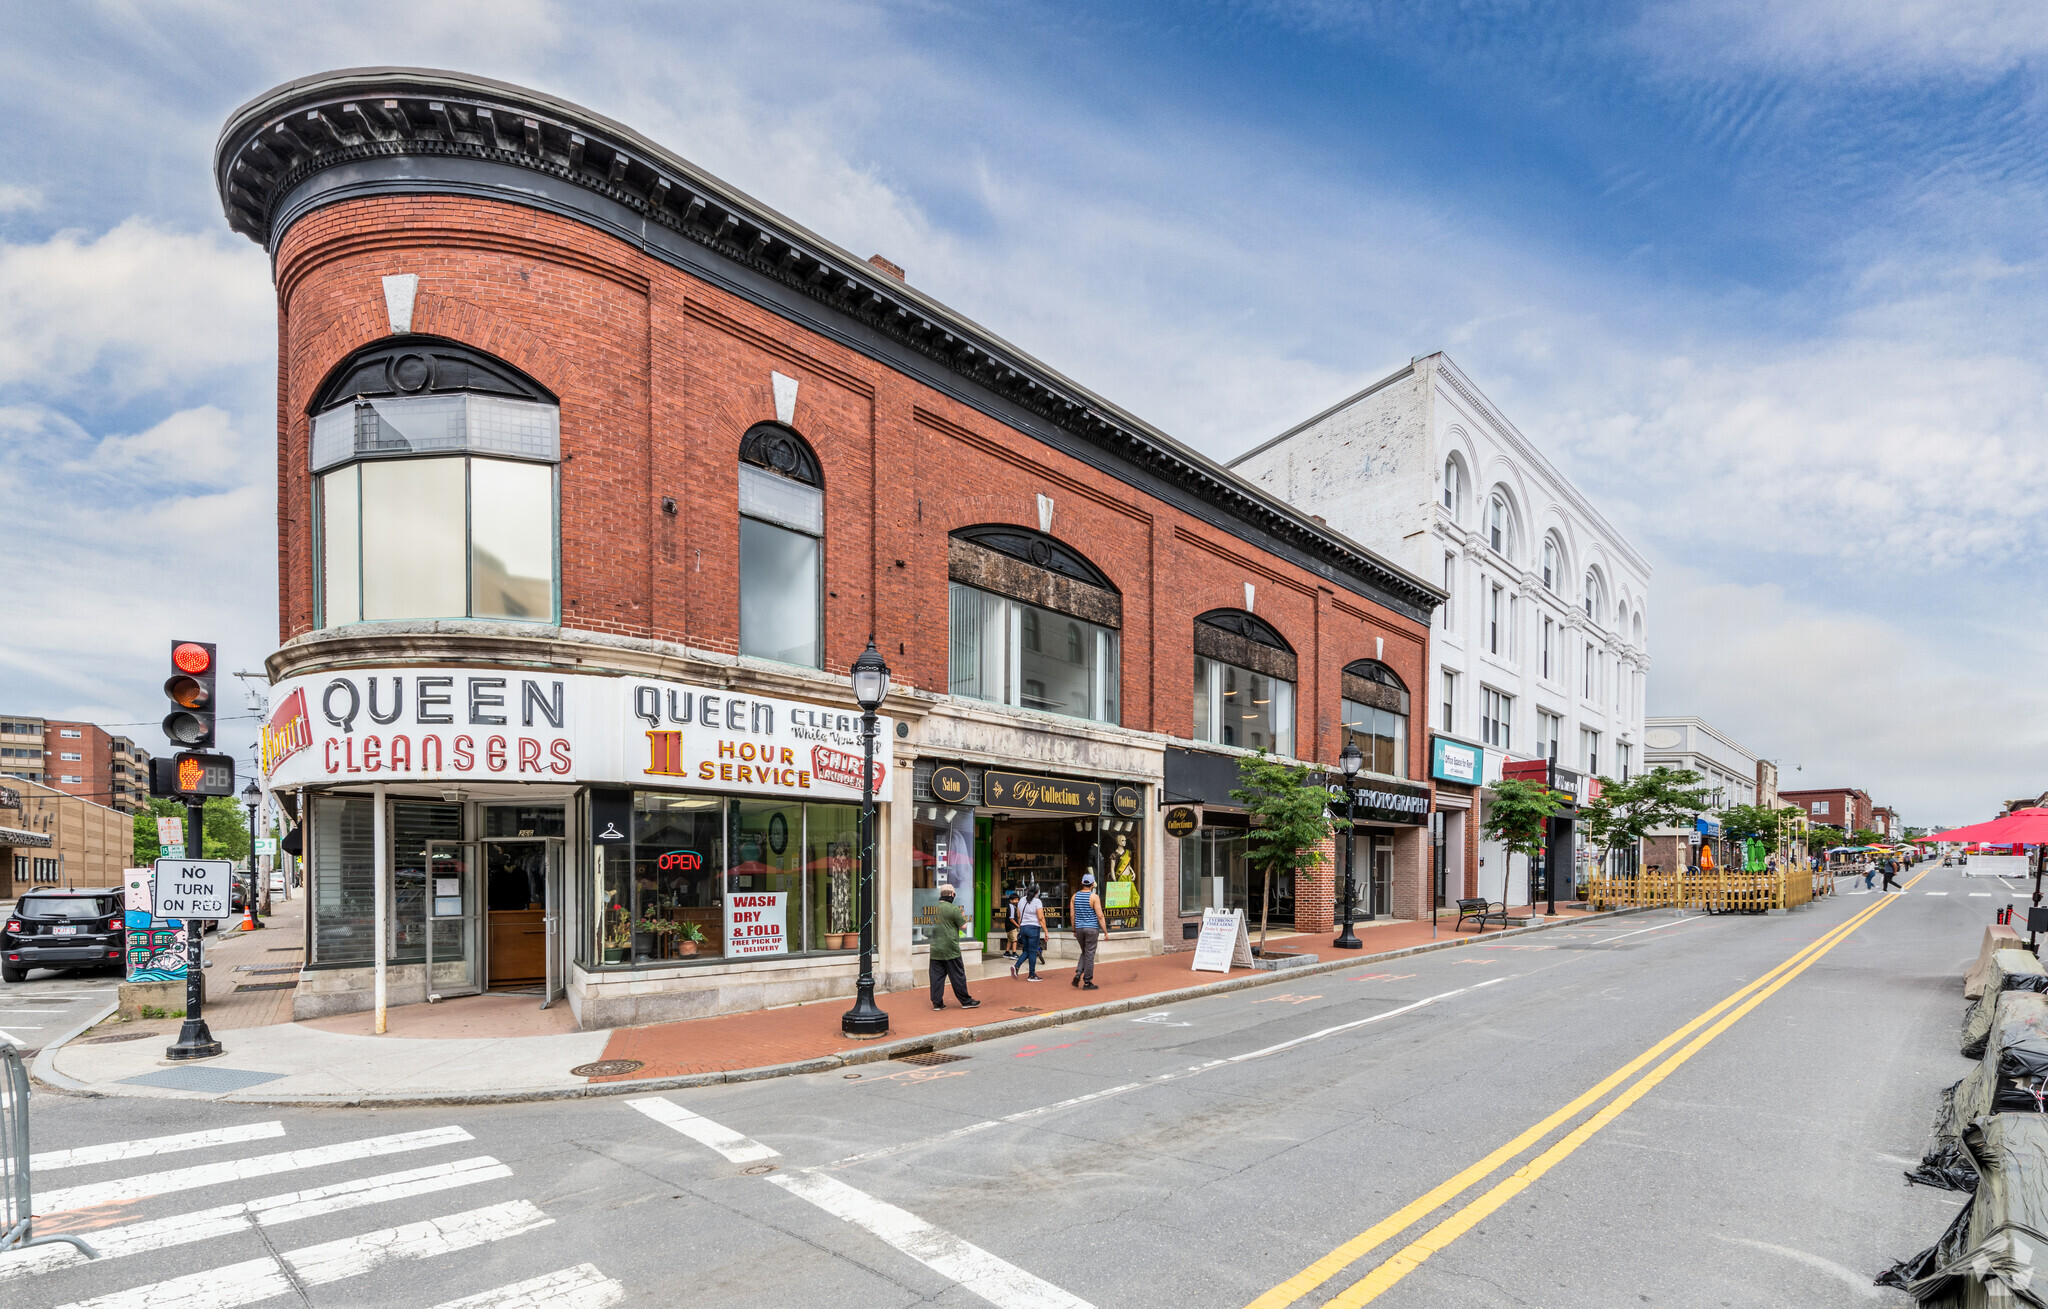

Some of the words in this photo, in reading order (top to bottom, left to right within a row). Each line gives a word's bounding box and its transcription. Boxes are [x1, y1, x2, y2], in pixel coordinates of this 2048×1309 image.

[323, 676, 564, 734] QUEEN
[635, 685, 773, 735] QUEEN
[324, 734, 571, 774] CLEANSERS
[644, 731, 687, 777] 1
[719, 740, 794, 766] HOUR
[699, 761, 811, 788] SERVICE
[942, 777, 960, 792] Salon
[1013, 780, 1040, 807] Raj
[1041, 786, 1080, 806] Collections
[1118, 796, 1136, 810] Clothing
[1358, 789, 1429, 814] PHOTOGRAPHY
[1173, 809, 1187, 820] Raj
[1168, 820, 1193, 829] Collections
[659, 855, 700, 870] OPEN
[182, 868, 206, 879] NO
[174, 884, 213, 895] TURN
[164, 900, 184, 911] ON
[193, 900, 222, 911] RED
[733, 896, 776, 907] WASH
[734, 911, 761, 923] DRY
[1103, 909, 1139, 917] ALTERATIONS
[733, 928, 743, 937] &
[747, 925, 779, 936] FOLD
